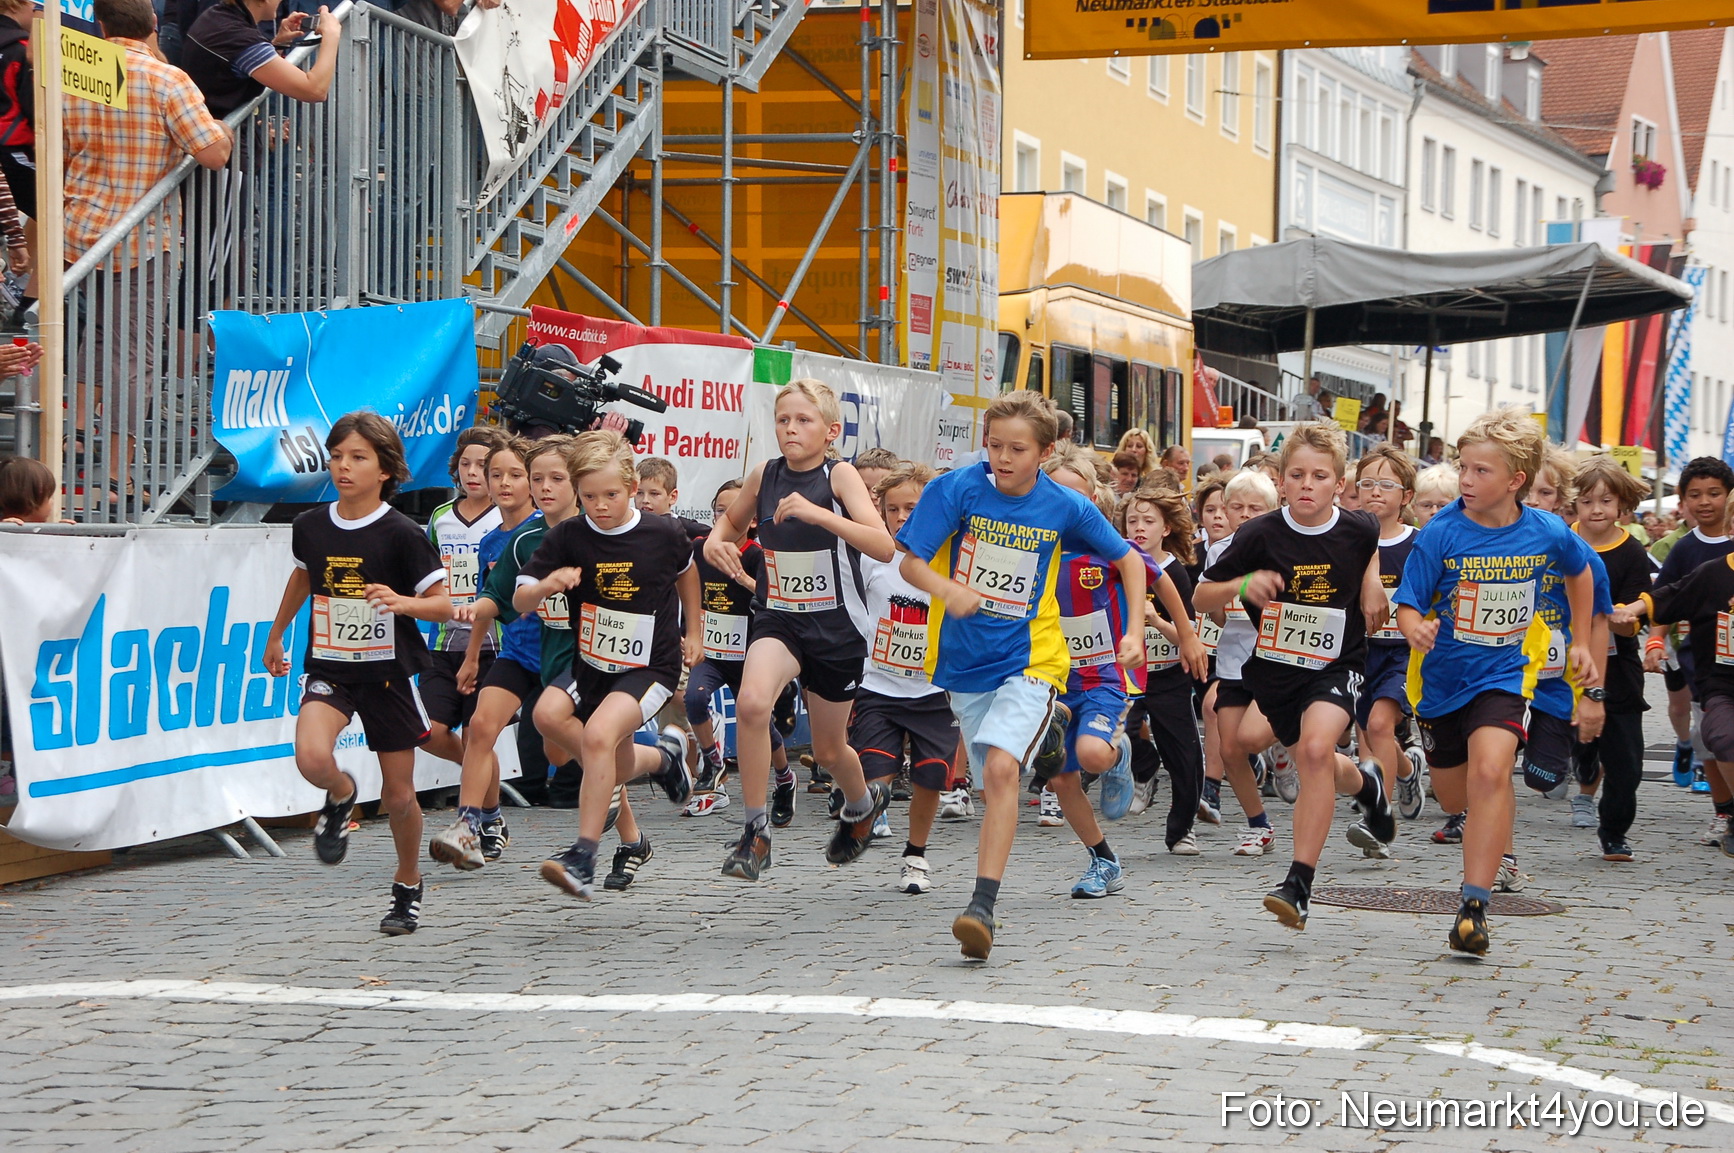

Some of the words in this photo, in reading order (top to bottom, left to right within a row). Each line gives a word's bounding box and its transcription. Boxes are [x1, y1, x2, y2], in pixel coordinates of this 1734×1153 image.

[62, 65, 112, 105] treuung
[221, 357, 294, 429] maxi
[664, 425, 741, 460] Partner.
[1613, 447, 1638, 457] Block
[970, 515, 1058, 542] NEUMARKTER
[452, 558, 468, 568] Luca
[1443, 559, 1460, 570] 10.
[1463, 554, 1547, 569] NEUMARKTER
[453, 573, 479, 588] 716
[975, 565, 1026, 594] 7325
[1460, 567, 1533, 581] STADTLAUF
[780, 575, 828, 593] 7283
[549, 596, 568, 612] 71
[1482, 589, 1527, 602] JULIAN
[597, 613, 625, 630] Lukas
[706, 614, 717, 626] Leo
[1284, 609, 1318, 625] Moritz
[1481, 606, 1528, 625] 7302
[334, 622, 386, 641] 7226
[706, 629, 741, 646] 7012
[892, 626, 924, 640] Markus
[1204, 626, 1220, 641] 71
[1282, 626, 1335, 651] 7158
[596, 632, 643, 656] 7130
